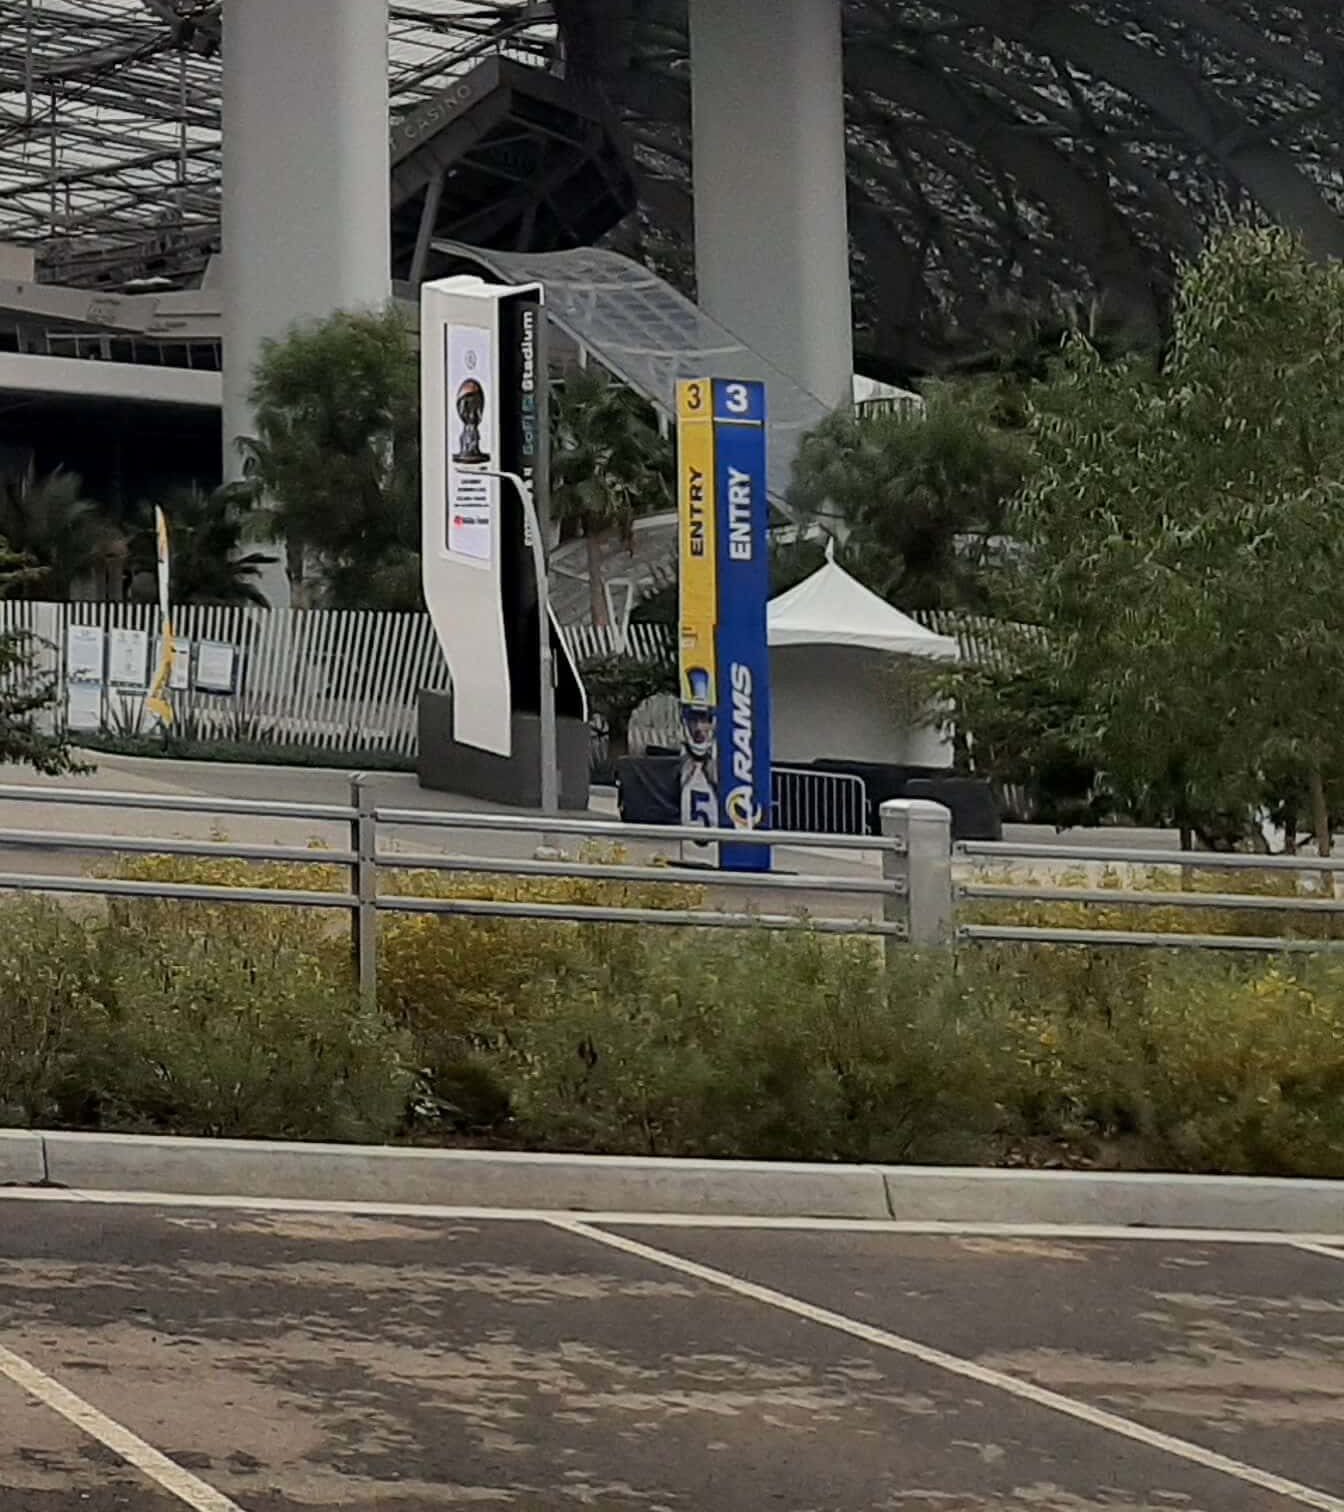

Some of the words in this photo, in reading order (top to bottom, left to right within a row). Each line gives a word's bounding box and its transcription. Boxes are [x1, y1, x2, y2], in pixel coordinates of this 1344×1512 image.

[520, 311, 534, 392] Stadium
[687, 384, 701, 410] 3
[726, 384, 748, 413] 3
[689, 466, 704, 558] ENTRY
[728, 466, 752, 560] ENTRY
[730, 662, 752, 783] RAMS
